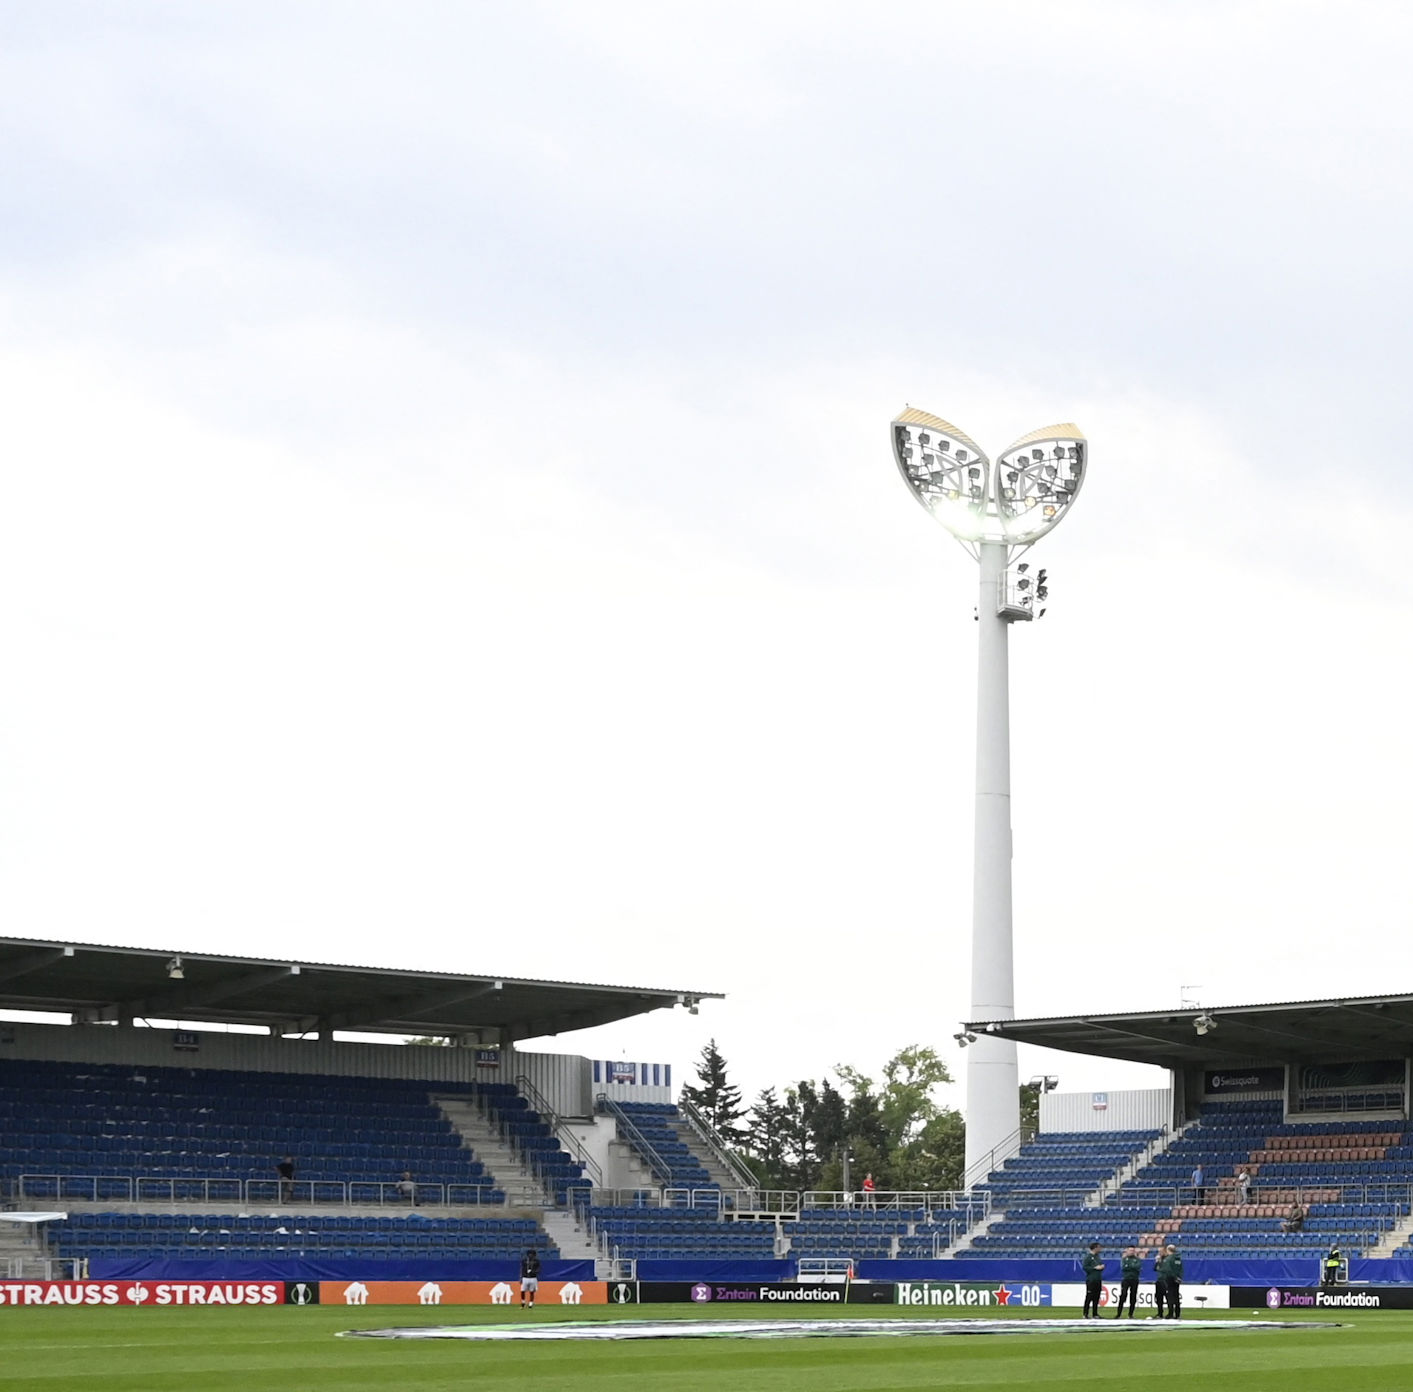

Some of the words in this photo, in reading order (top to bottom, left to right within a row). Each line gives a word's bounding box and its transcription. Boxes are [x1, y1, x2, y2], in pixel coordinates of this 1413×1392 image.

[155, 1284, 277, 1305] STRAUSS
[759, 1287, 840, 1301] Foundation
[897, 1284, 990, 1305] Heineken
[1315, 1291, 1380, 1307] Foundation
